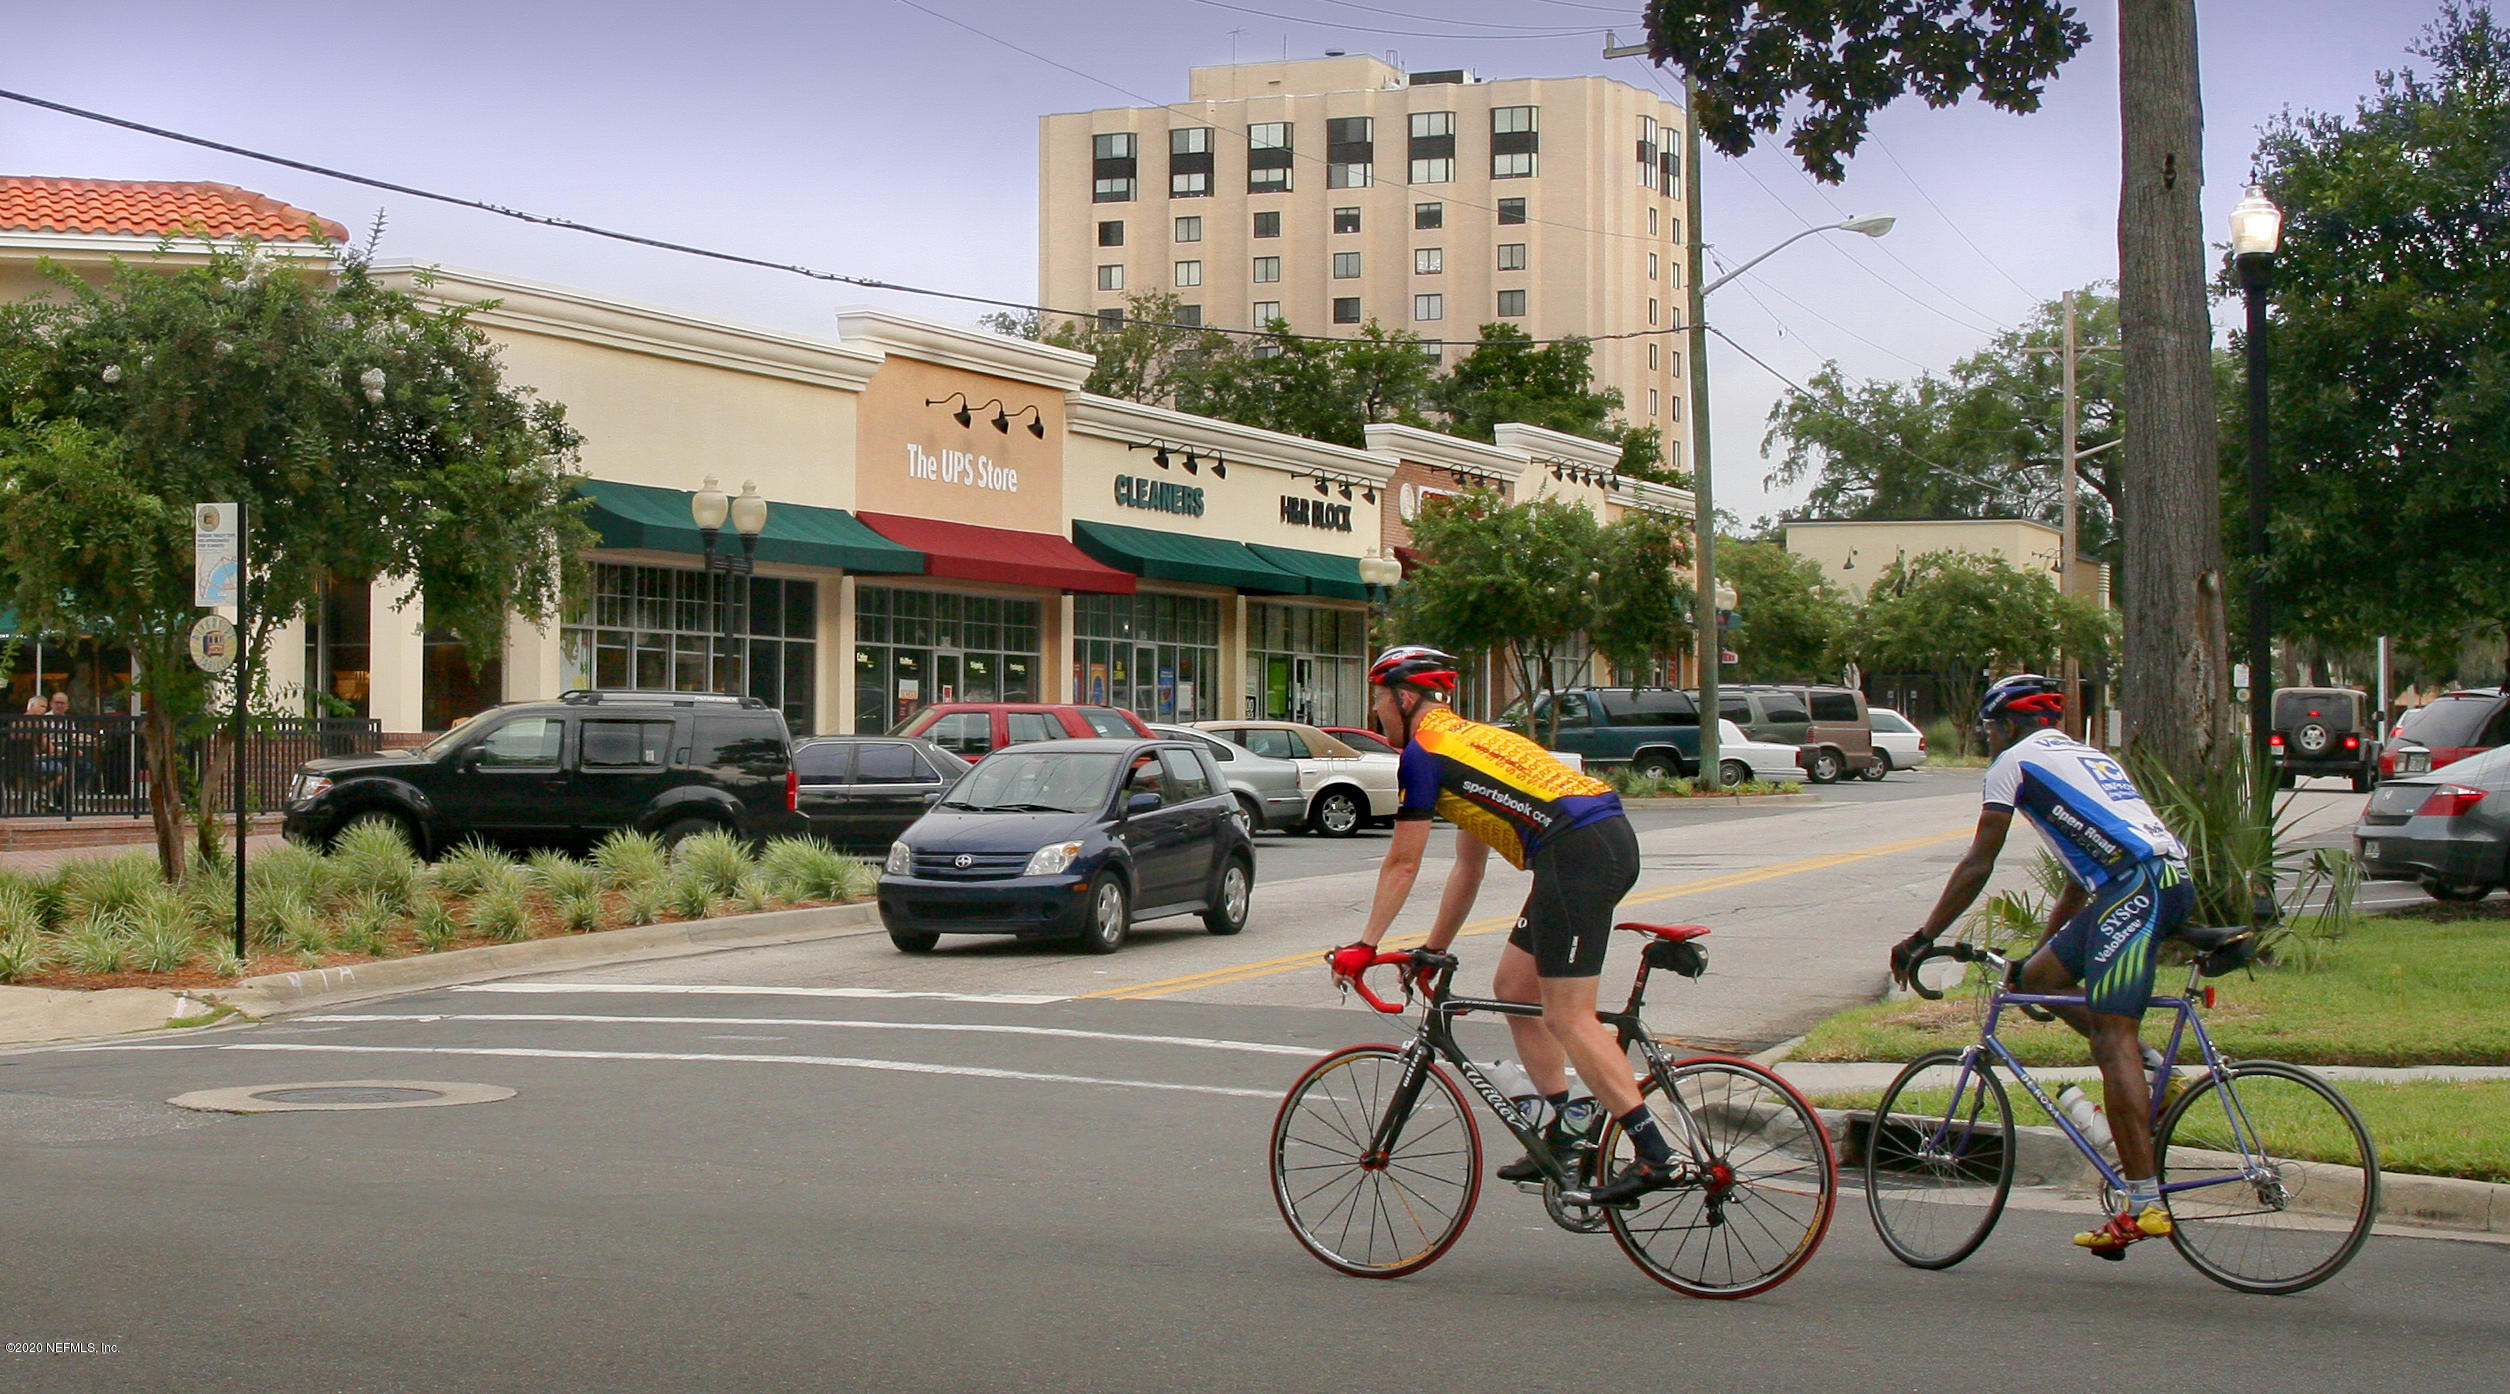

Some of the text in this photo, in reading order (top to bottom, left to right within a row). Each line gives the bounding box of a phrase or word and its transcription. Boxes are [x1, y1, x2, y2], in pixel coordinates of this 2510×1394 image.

[906, 443, 1018, 493] The UPS Store
[1114, 474, 1205, 518] CLEANERS
[1311, 500, 1352, 533] BLOCK
[2052, 804, 2084, 831] Open
[2084, 826, 2117, 854] Road
[2100, 895, 2150, 936] SYSCO
[2094, 919, 2143, 962] VeloBrew
